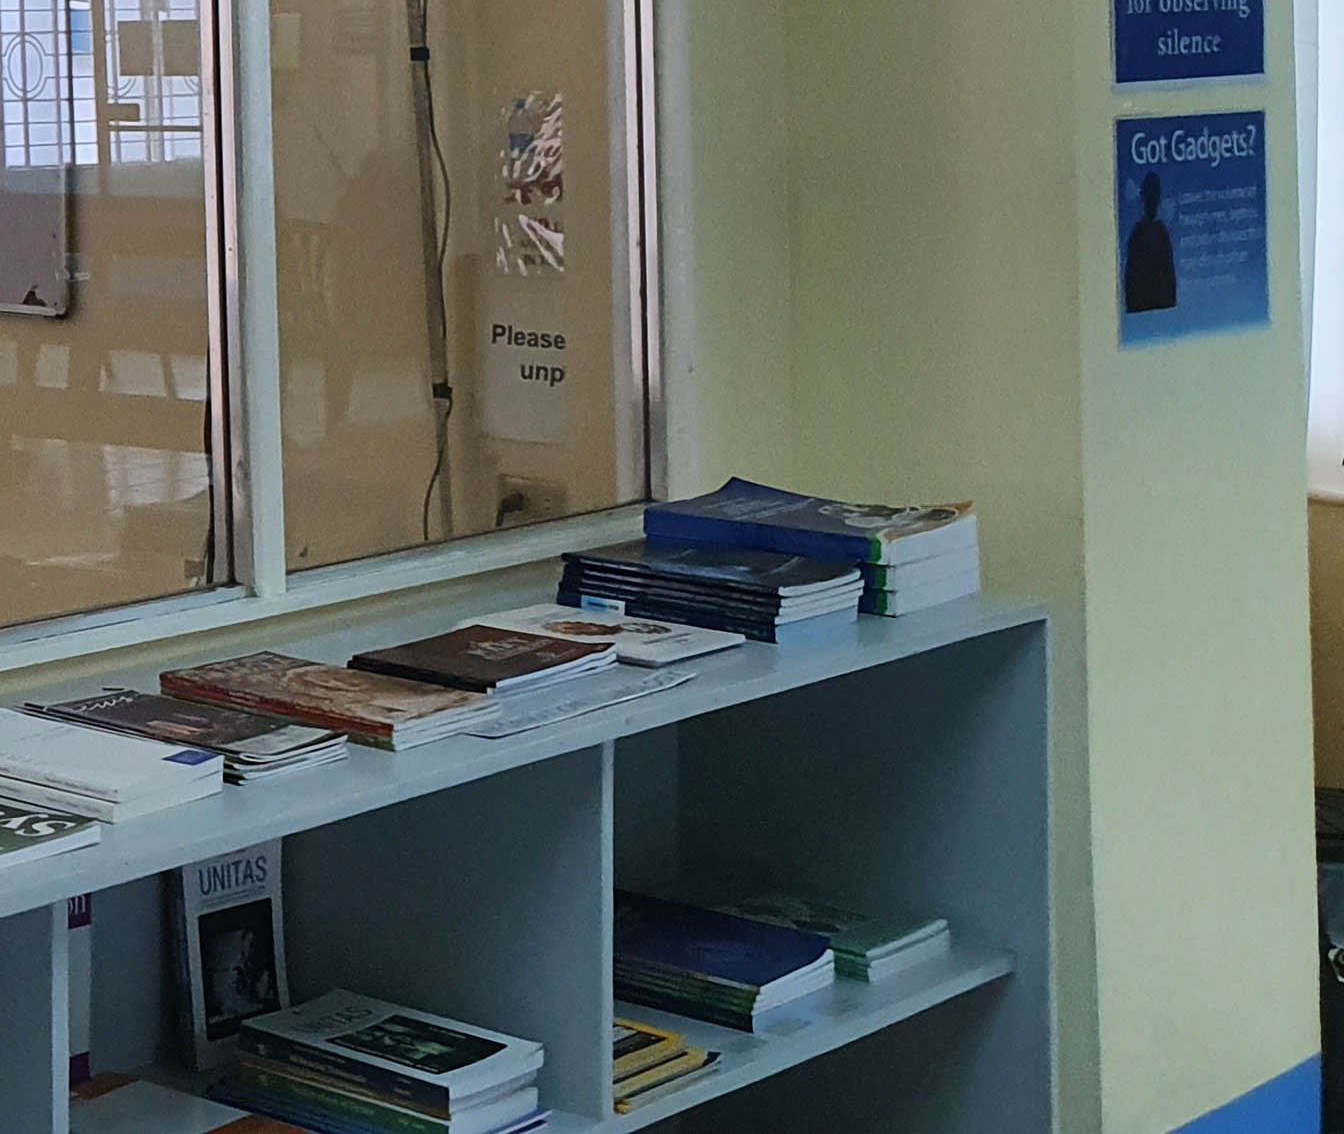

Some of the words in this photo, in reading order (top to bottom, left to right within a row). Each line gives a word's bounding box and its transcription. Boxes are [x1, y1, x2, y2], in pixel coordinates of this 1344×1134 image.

[1158, 28, 1221, 55] silence
[1131, 133, 1168, 165] Got
[1171, 125, 1256, 168] Gadgets?
[491, 323, 567, 350] Please
[198, 855, 268, 896] UNITAS
